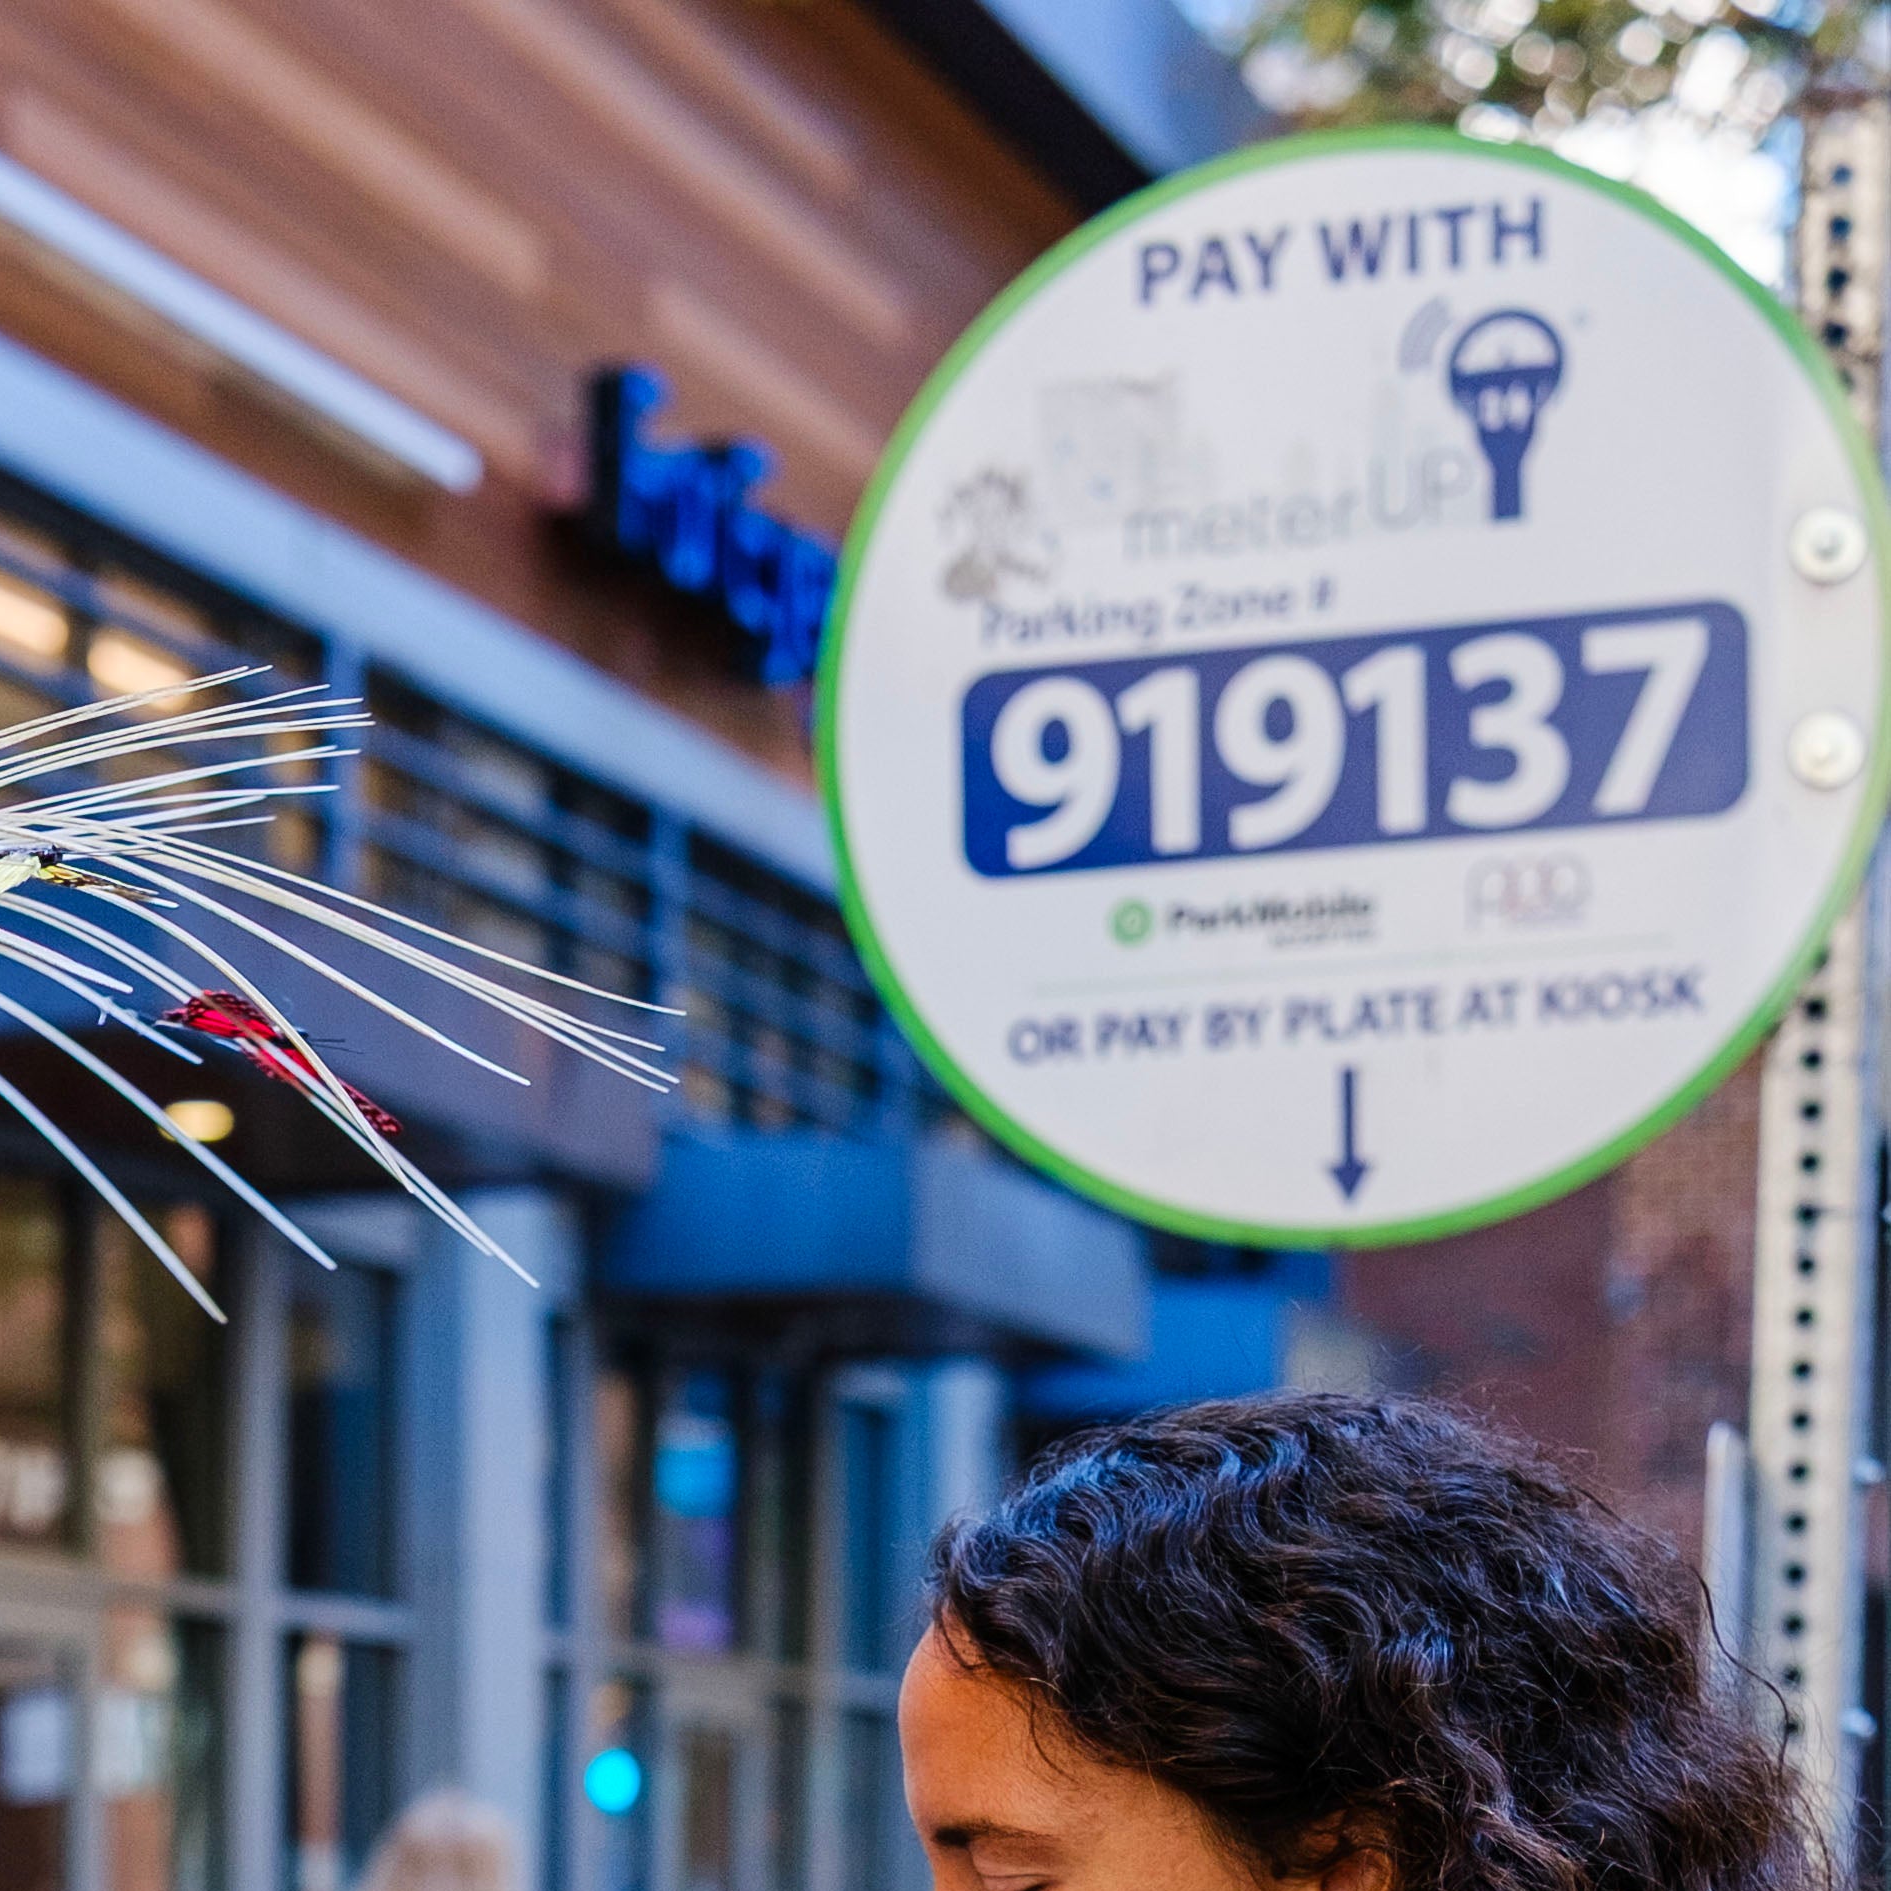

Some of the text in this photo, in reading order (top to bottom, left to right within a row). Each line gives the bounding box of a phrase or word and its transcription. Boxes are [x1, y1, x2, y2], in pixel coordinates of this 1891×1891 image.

[1140, 197, 1543, 305] PAY WITH
[980, 598, 1164, 648] Parking
[1175, 582, 1295, 629] Zone
[990, 617, 1711, 871] 919137
[1009, 965, 1705, 1065] OR PAY BY PLATE AT KIOSK
